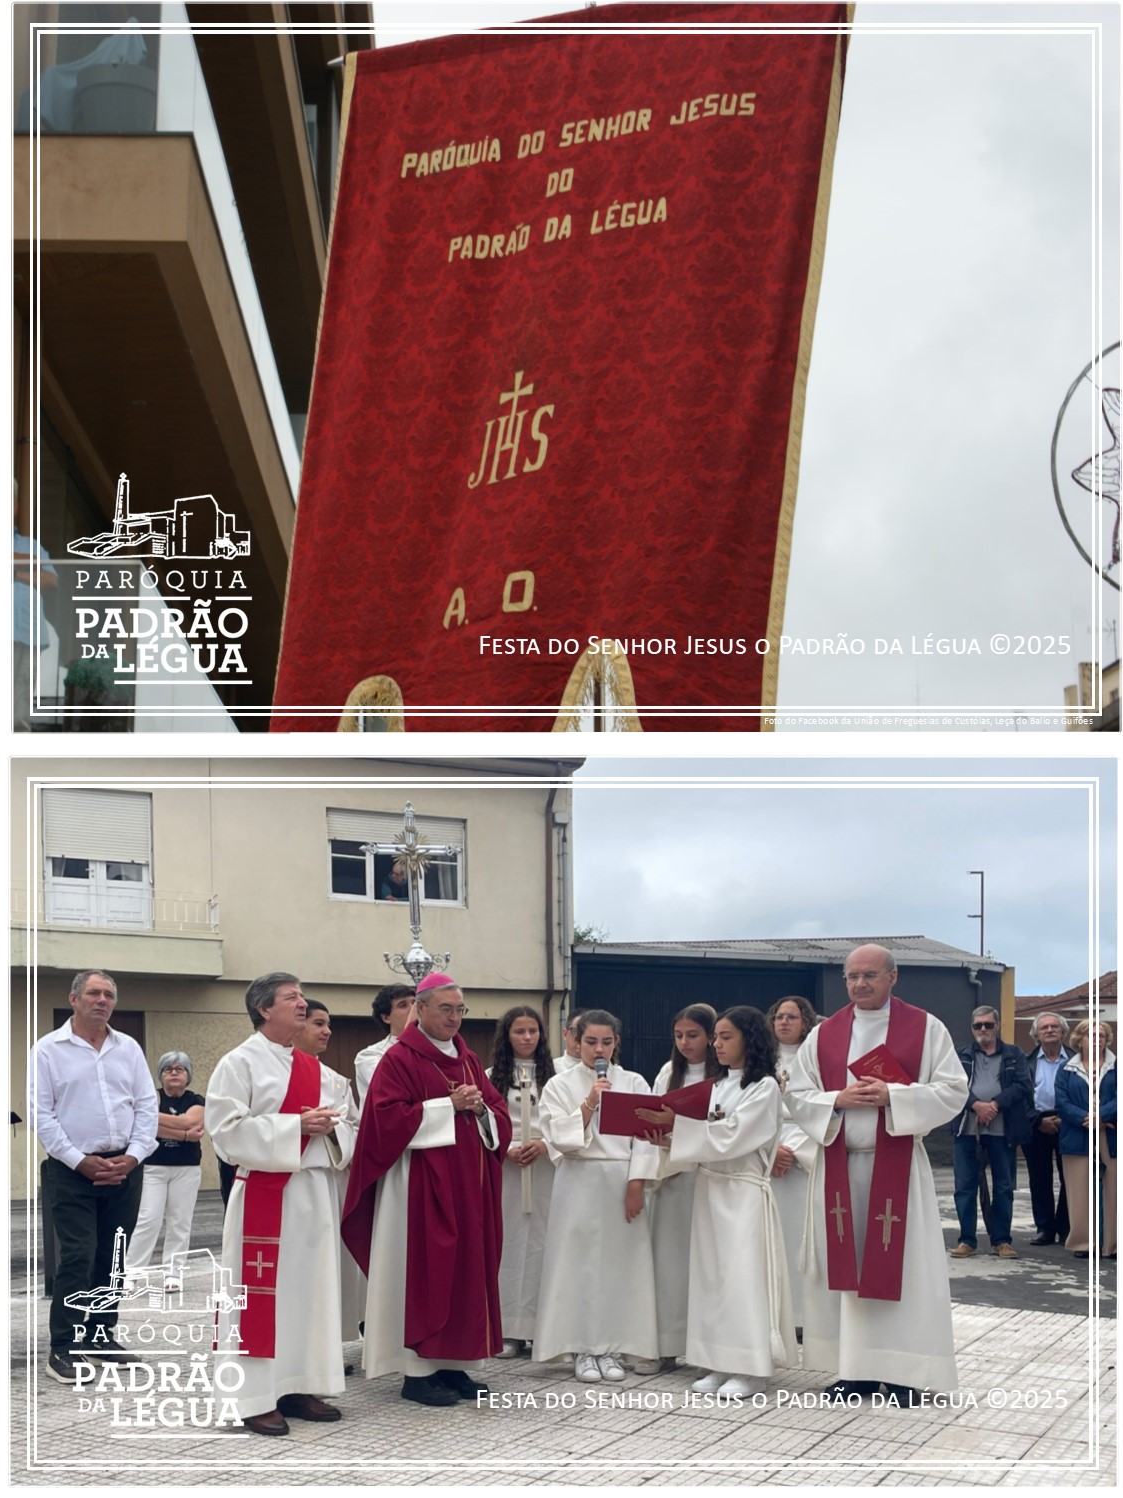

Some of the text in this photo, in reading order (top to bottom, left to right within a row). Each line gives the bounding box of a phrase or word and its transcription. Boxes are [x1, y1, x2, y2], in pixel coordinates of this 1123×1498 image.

[400, 92, 757, 178] PARÓQUIA DO SENHOR JESUS
[546, 168, 574, 198] DO
[448, 197, 668, 263] PADRÃO DA LÉGUA
